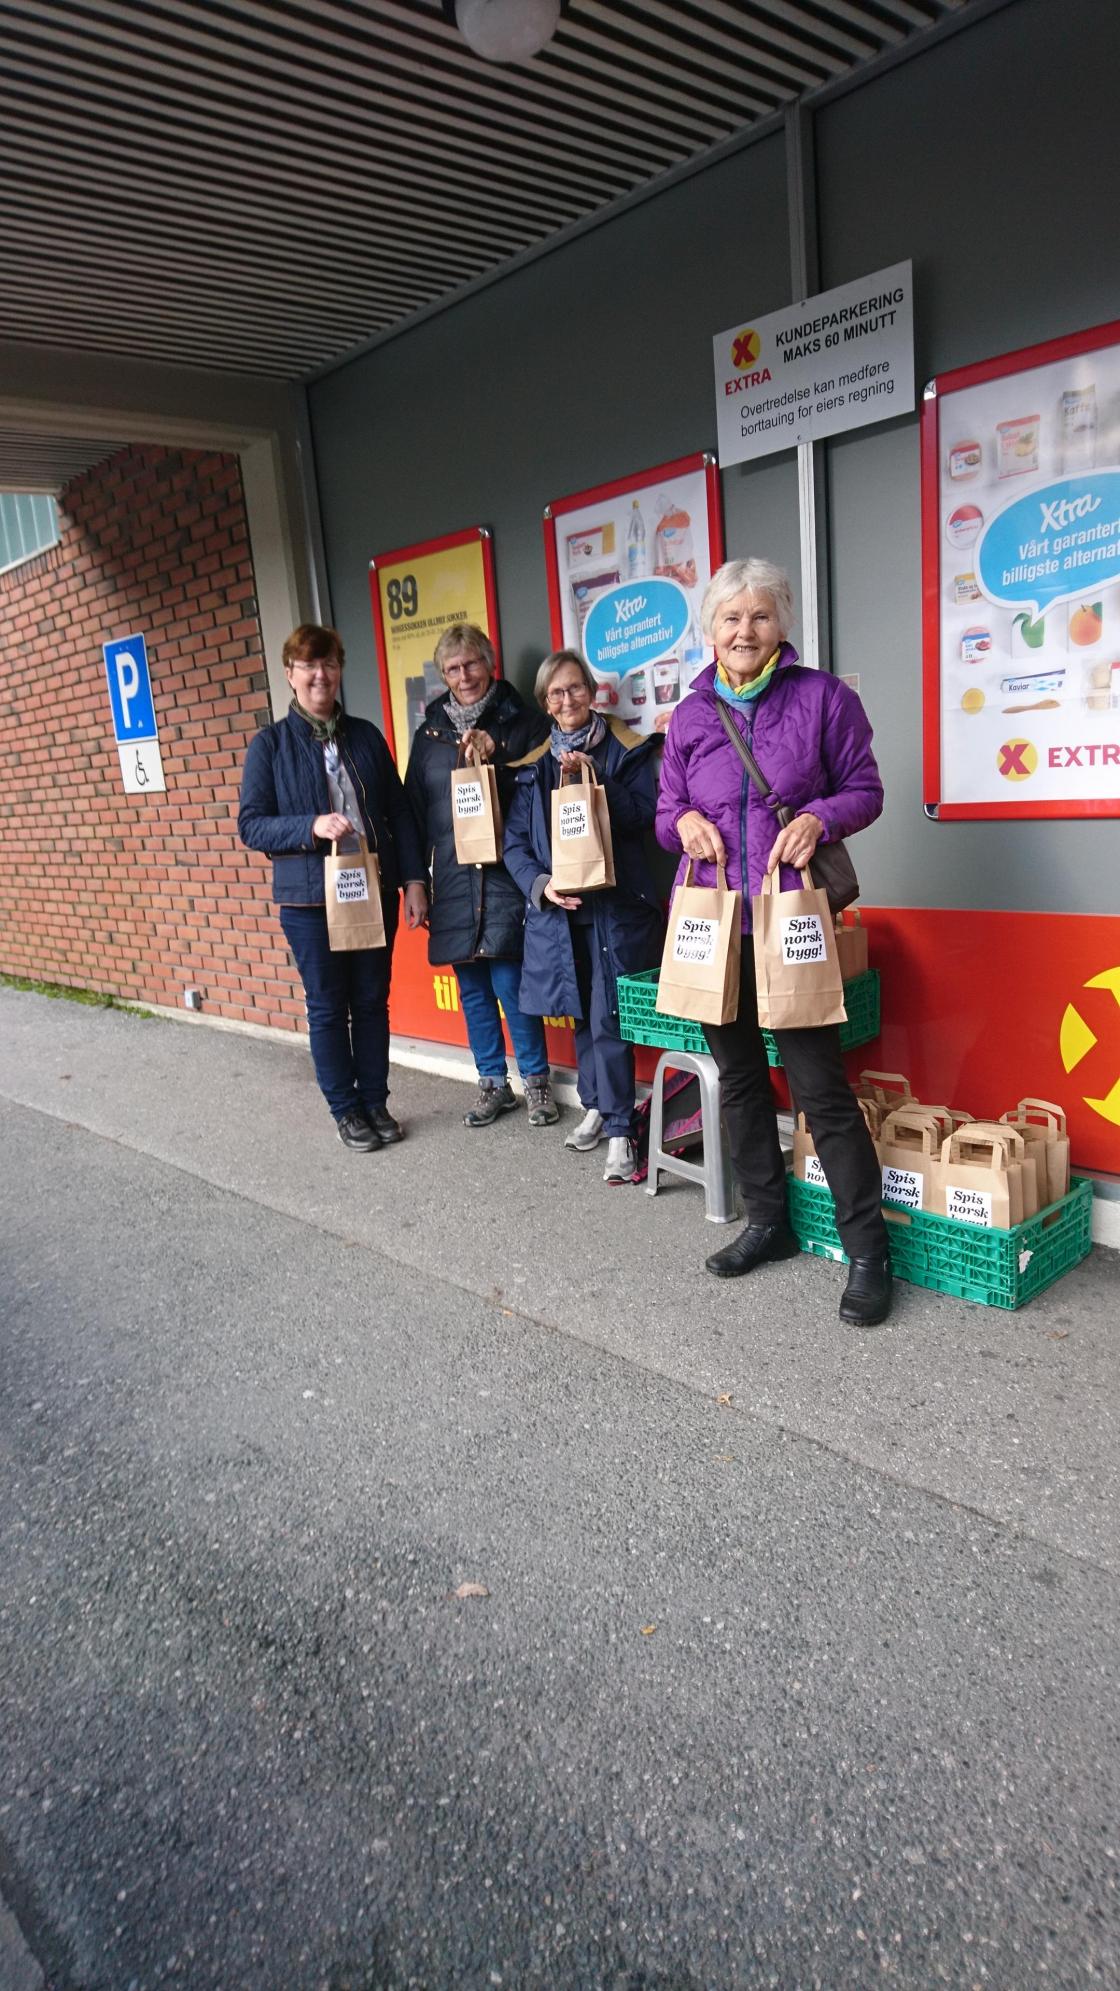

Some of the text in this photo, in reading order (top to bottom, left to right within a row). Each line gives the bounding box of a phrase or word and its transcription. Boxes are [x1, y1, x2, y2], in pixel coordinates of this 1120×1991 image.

[776, 288, 904, 347] KUNDEPARKERING
[783, 310, 896, 363] MAKS 60 MINUTT
[724, 368, 772, 396] EXTRA
[741, 361, 890, 419] Overtredelse kan medføre
[741, 380, 894, 437] borttauing for eiers regning
[1040, 493, 1102, 533] Xtra
[1019, 538, 1050, 560] Vårt
[1002, 560, 1059, 586] billigste
[386, 574, 418, 620] 89
[614, 595, 647, 622] Xtra
[605, 612, 661, 642] Vårt garantert
[598, 625, 673, 661] billigste alternativ!
[115, 652, 139, 728] P
[1008, 682, 1030, 692] Kaviar
[458, 785, 476, 795] Spis
[456, 794, 480, 804] norsk
[458, 803, 481, 814] bygg!
[562, 804, 580, 815] Spis
[560, 813, 586, 825] norsk
[562, 824, 586, 836] bygg!
[340, 870, 361, 880] Spis
[337, 879, 366, 888] norsk
[339, 888, 364, 899] bygg!
[682, 920, 711, 932] Spis
[788, 918, 816, 932] Spis
[784, 930, 822, 945] norsk
[786, 944, 822, 960] bygg!
[433, 976, 458, 1012] til
[807, 1172, 824, 1182] nor
[888, 1170, 916, 1184] Spis
[882, 1182, 920, 1198] norsk
[954, 1190, 983, 1205] Spis
[949, 1203, 988, 1218] norsk
